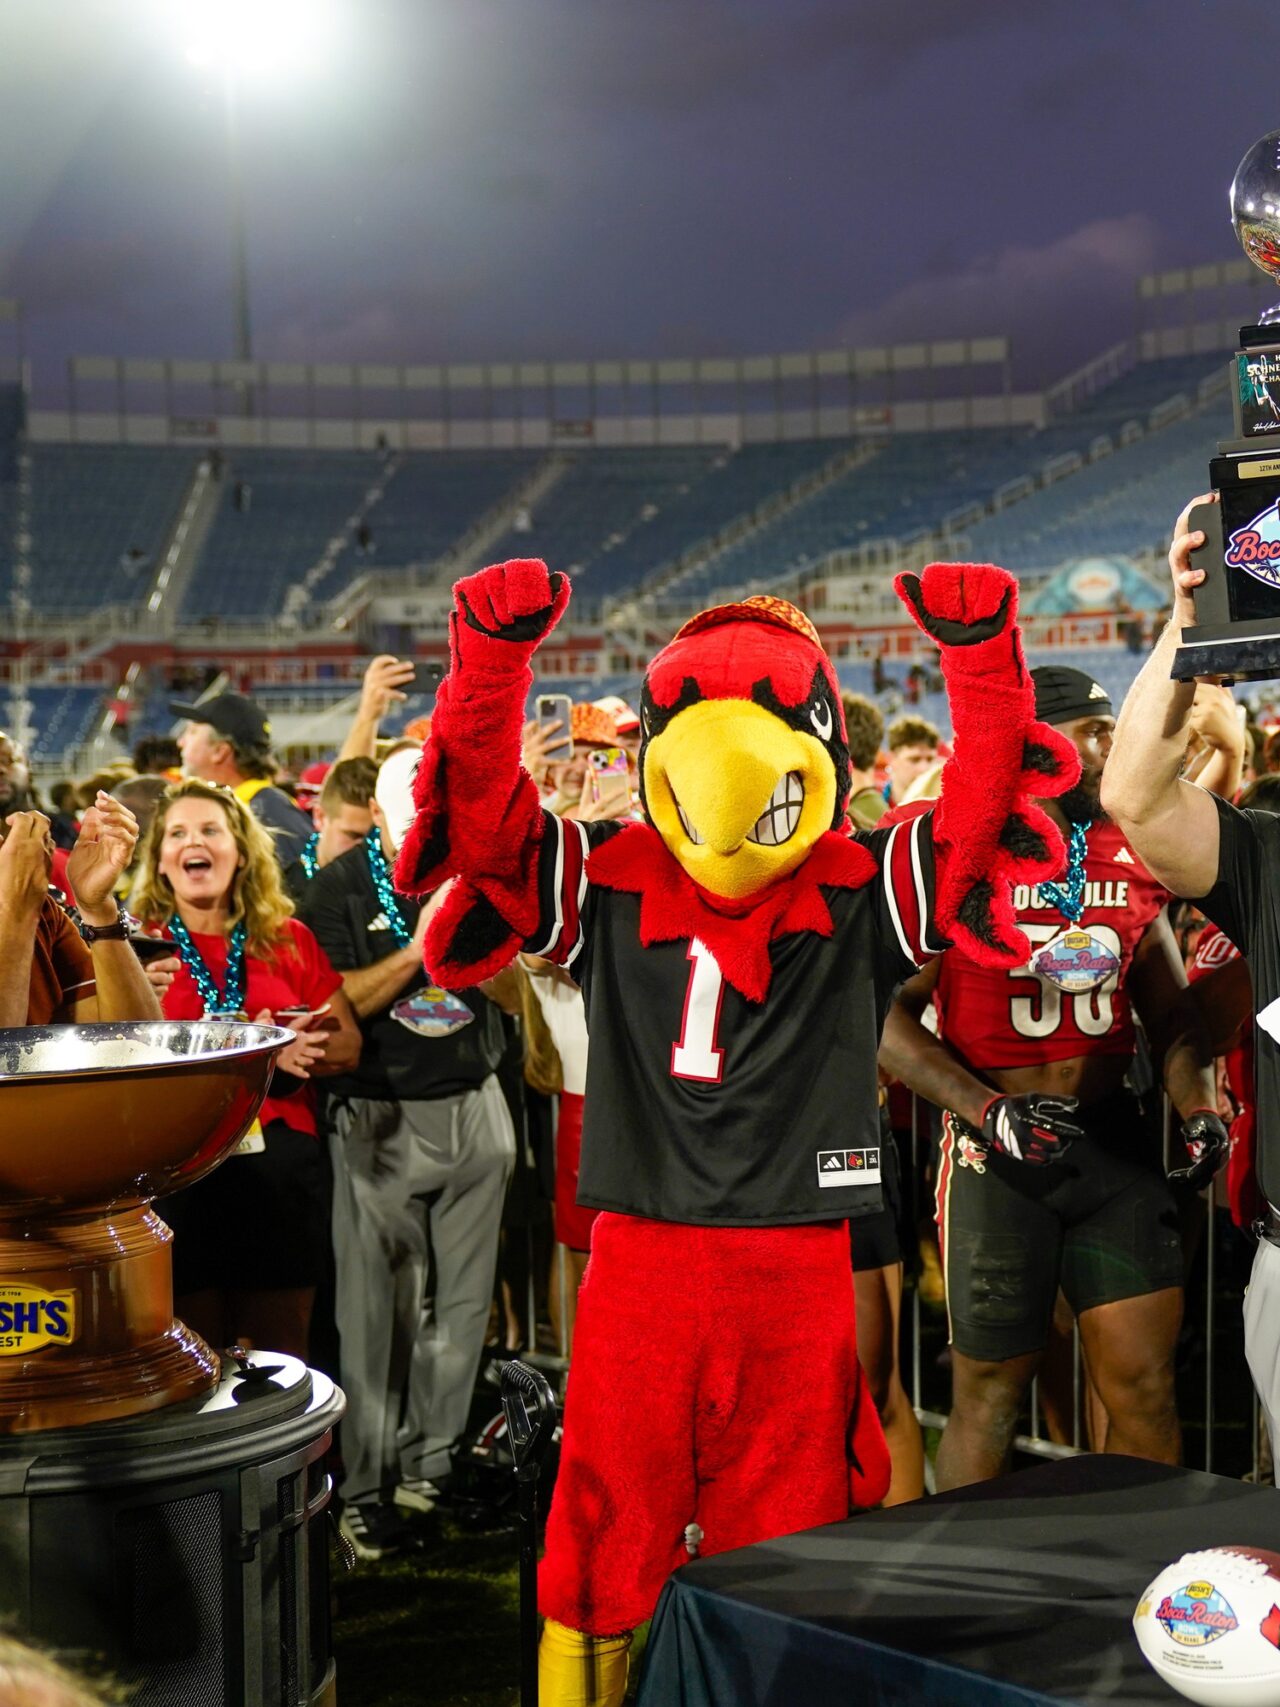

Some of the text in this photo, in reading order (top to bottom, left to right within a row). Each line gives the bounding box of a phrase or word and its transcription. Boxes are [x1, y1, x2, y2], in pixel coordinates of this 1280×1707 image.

[670, 936, 726, 1083] 1
[0, 1299, 68, 1337] SH'S
[0, 1335, 23, 1348] EST
[1156, 1597, 1237, 1630] Boca Raton
